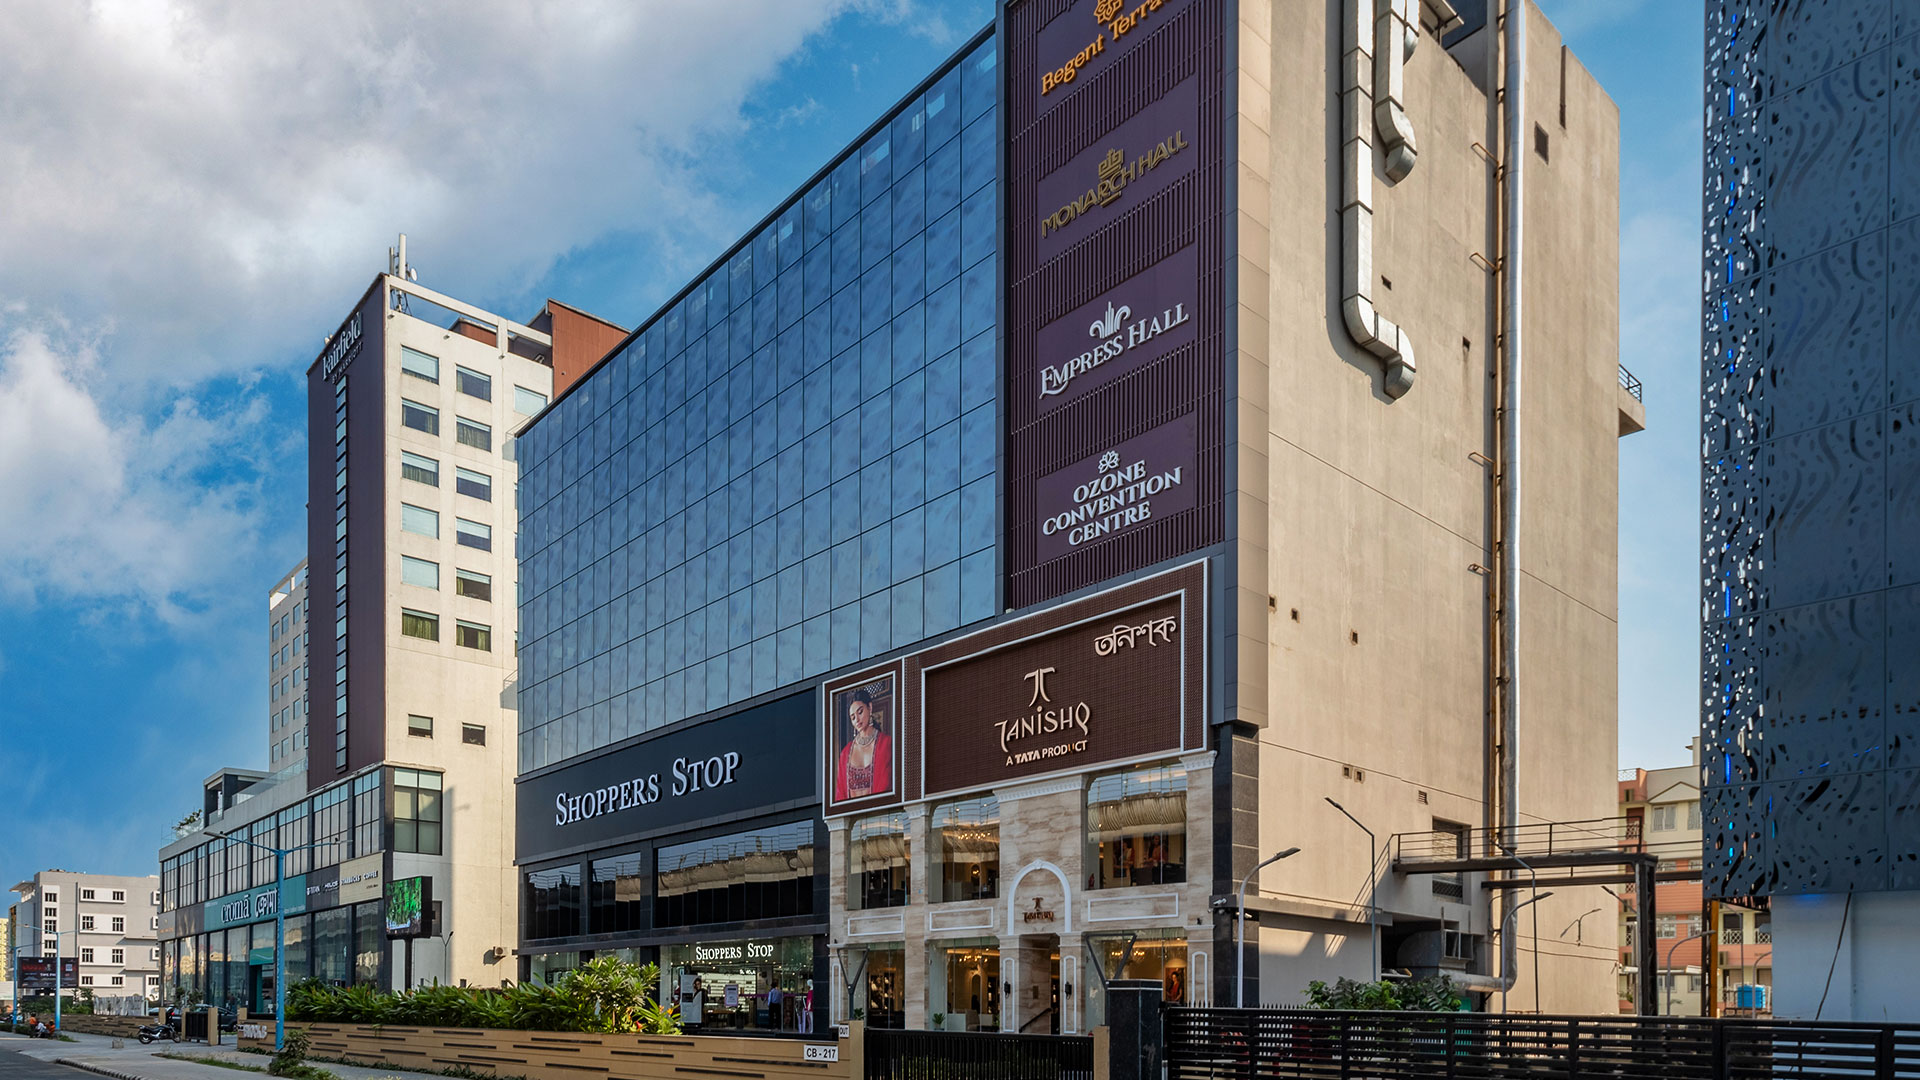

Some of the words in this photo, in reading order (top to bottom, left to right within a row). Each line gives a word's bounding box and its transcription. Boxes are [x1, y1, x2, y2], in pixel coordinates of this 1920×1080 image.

[1041, 33, 1104, 95] Regent
[1041, 161, 1136, 238] MONARCH
[1139, 130, 1188, 176] HALL
[322, 311, 362, 381] Fairfield
[1039, 335, 1124, 399] EMPRESS
[1127, 303, 1190, 350] HALL
[1042, 466, 1183, 535] CONVENTION
[1073, 460, 1147, 503] OZONE
[1068, 501, 1151, 546] CENTRE
[1005, 756, 1014, 766] A
[1015, 750, 1041, 764] TATA
[1042, 740, 1088, 758] PRODUCT
[555, 774, 660, 826] SHOPPERS
[672, 752, 740, 796] STOP
[696, 946, 742, 960] SHOPPERS
[747, 943, 774, 957] STOP
[806, 1048, 817, 1058] CB
[823, 1049, 836, 1058] 217
